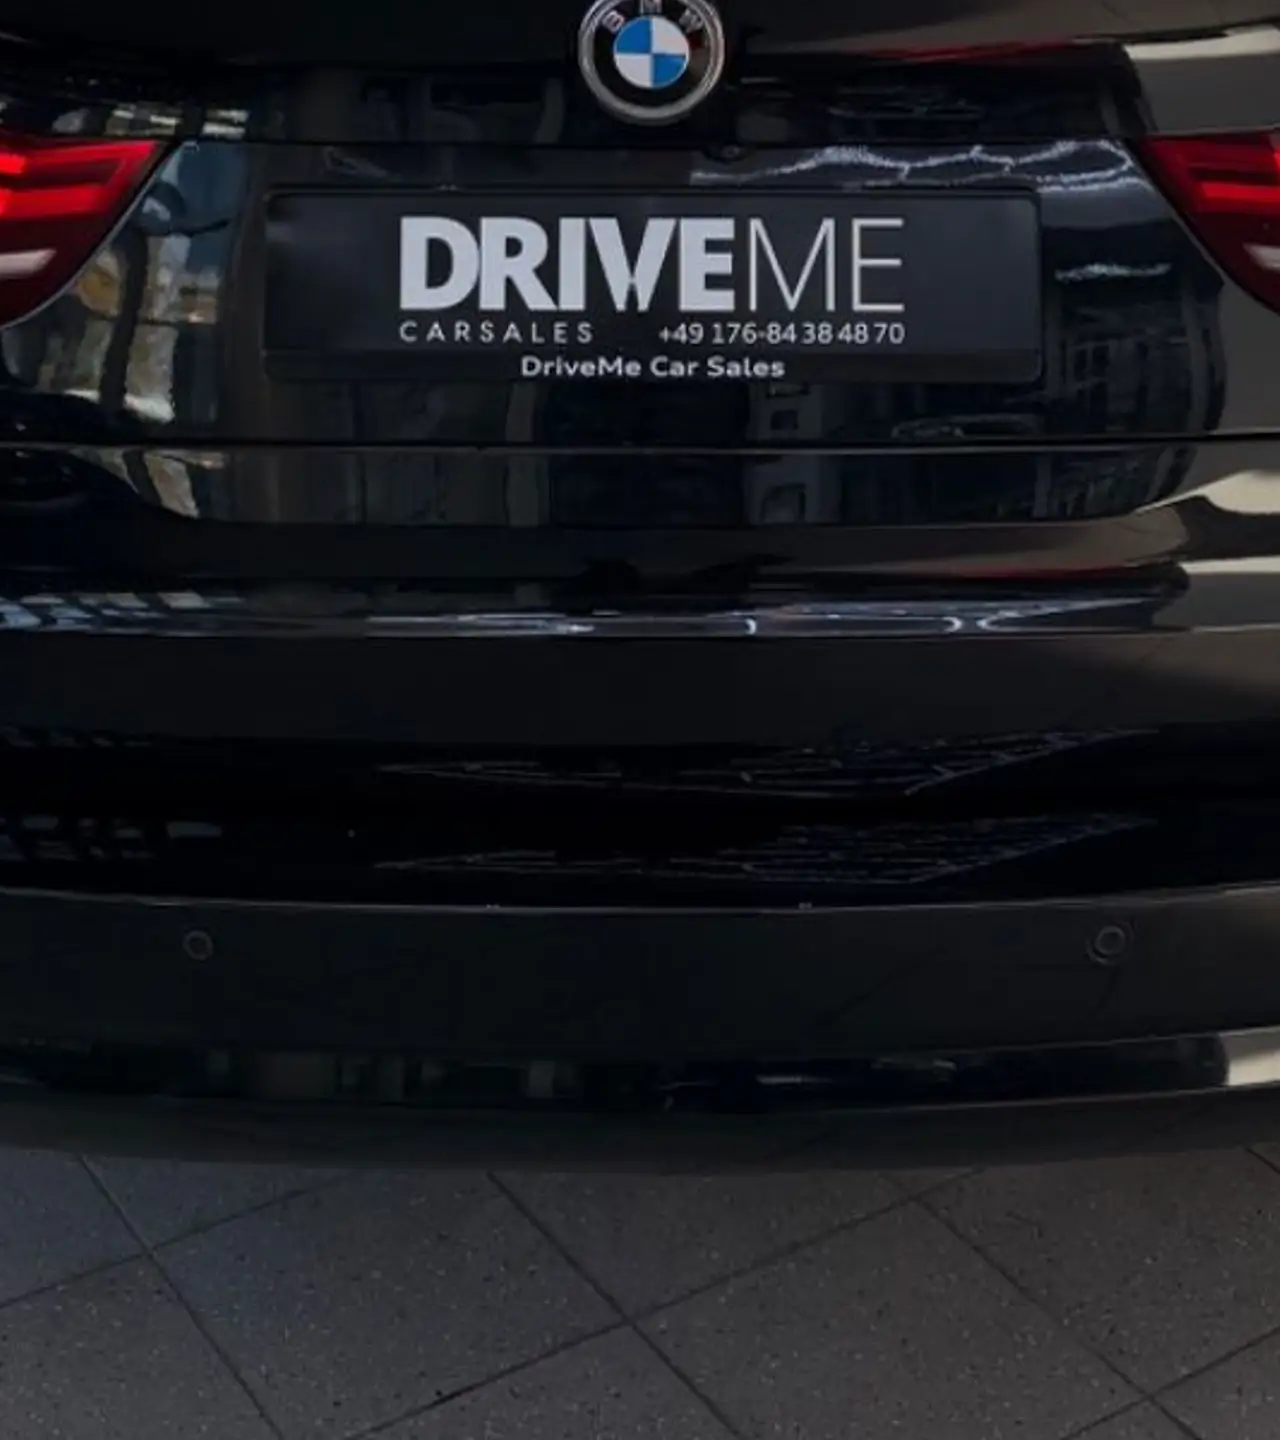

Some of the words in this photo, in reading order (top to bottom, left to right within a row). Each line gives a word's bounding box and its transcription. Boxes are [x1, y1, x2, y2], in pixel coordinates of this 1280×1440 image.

[399, 320, 593, 344] CARSALES
[658, 321, 705, 345] +49
[520, 355, 642, 378] DriveMe
[649, 355, 700, 378] Car
[706, 355, 786, 379] Sales
